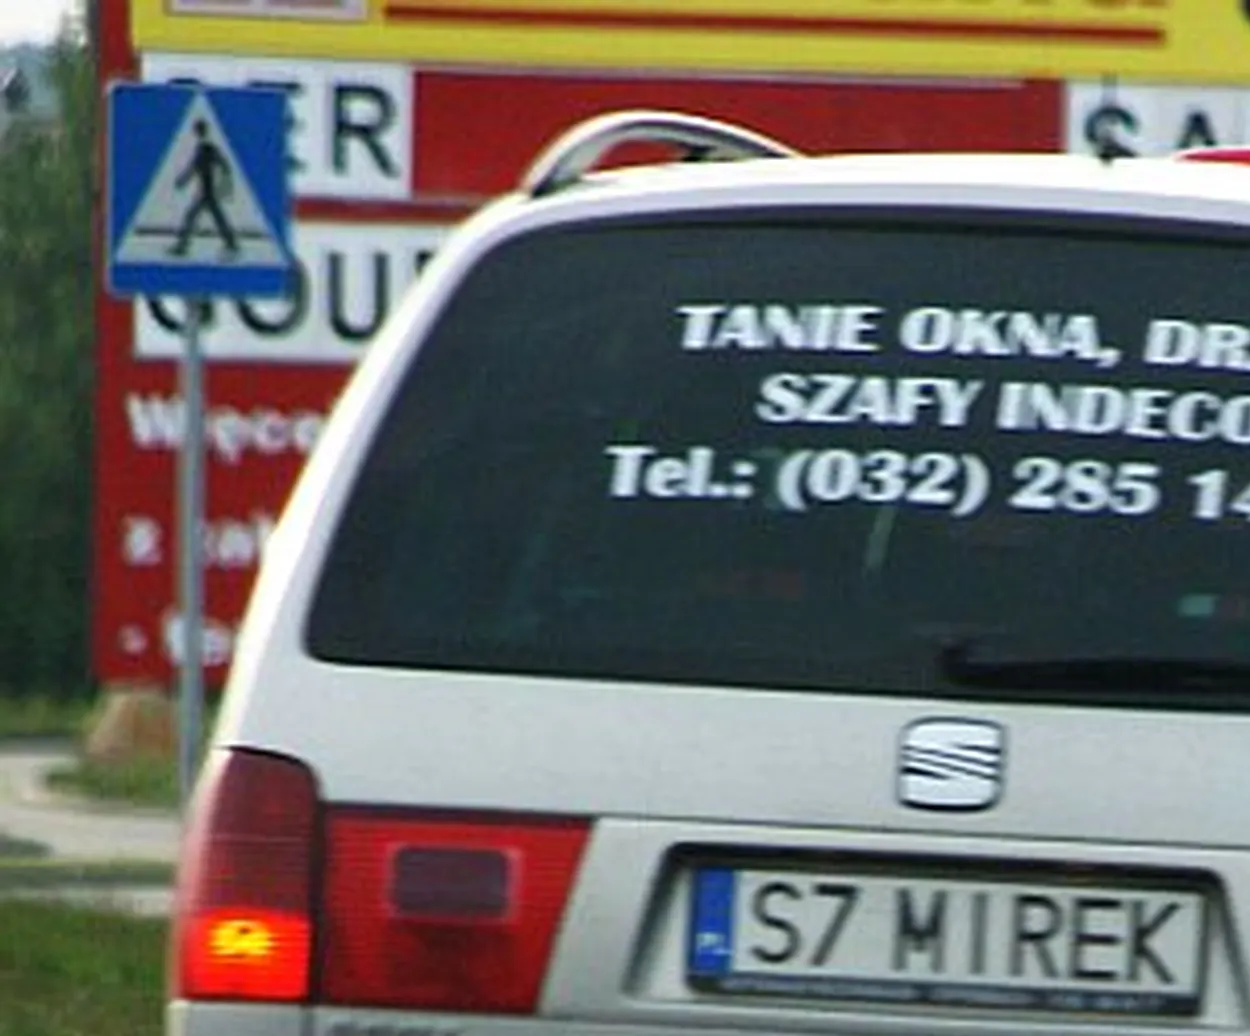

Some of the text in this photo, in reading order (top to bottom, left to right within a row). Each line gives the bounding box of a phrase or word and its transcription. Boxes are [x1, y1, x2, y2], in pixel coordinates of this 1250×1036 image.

[676, 304, 886, 351] TANIE
[900, 307, 1122, 368] OKNA,
[754, 373, 984, 427] SZAFY
[606, 446, 757, 497] Tel.:
[776, 449, 990, 516] (032)
[1010, 456, 1163, 515] 285
[749, 882, 1183, 985] S7 MIREK
